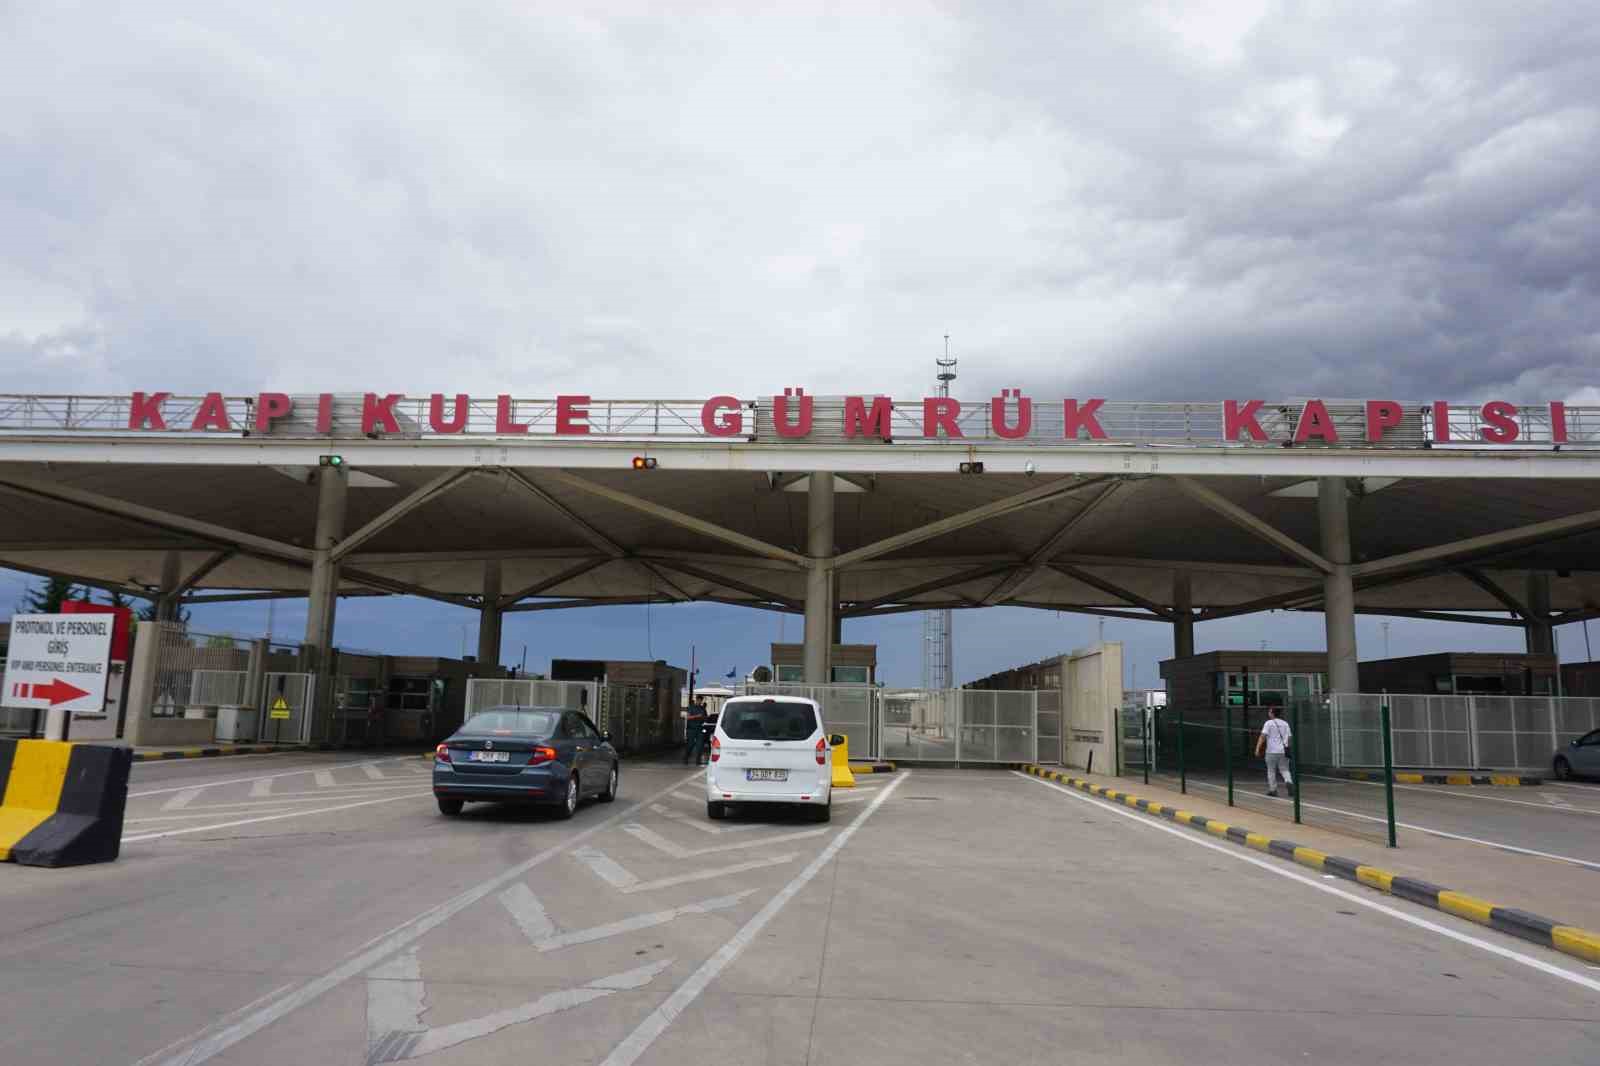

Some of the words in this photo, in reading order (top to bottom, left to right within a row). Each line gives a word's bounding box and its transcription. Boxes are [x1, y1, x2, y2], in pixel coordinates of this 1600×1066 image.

[128, 393, 592, 435] KAPIKULE
[701, 388, 1105, 440] GÜMRÜK
[1223, 399, 1566, 443] KAPISI
[15, 621, 54, 634] PROTOKOL
[55, 621, 66, 635] VE
[67, 621, 107, 636] PERSONEL
[47, 638, 69, 657] GİRİŞ
